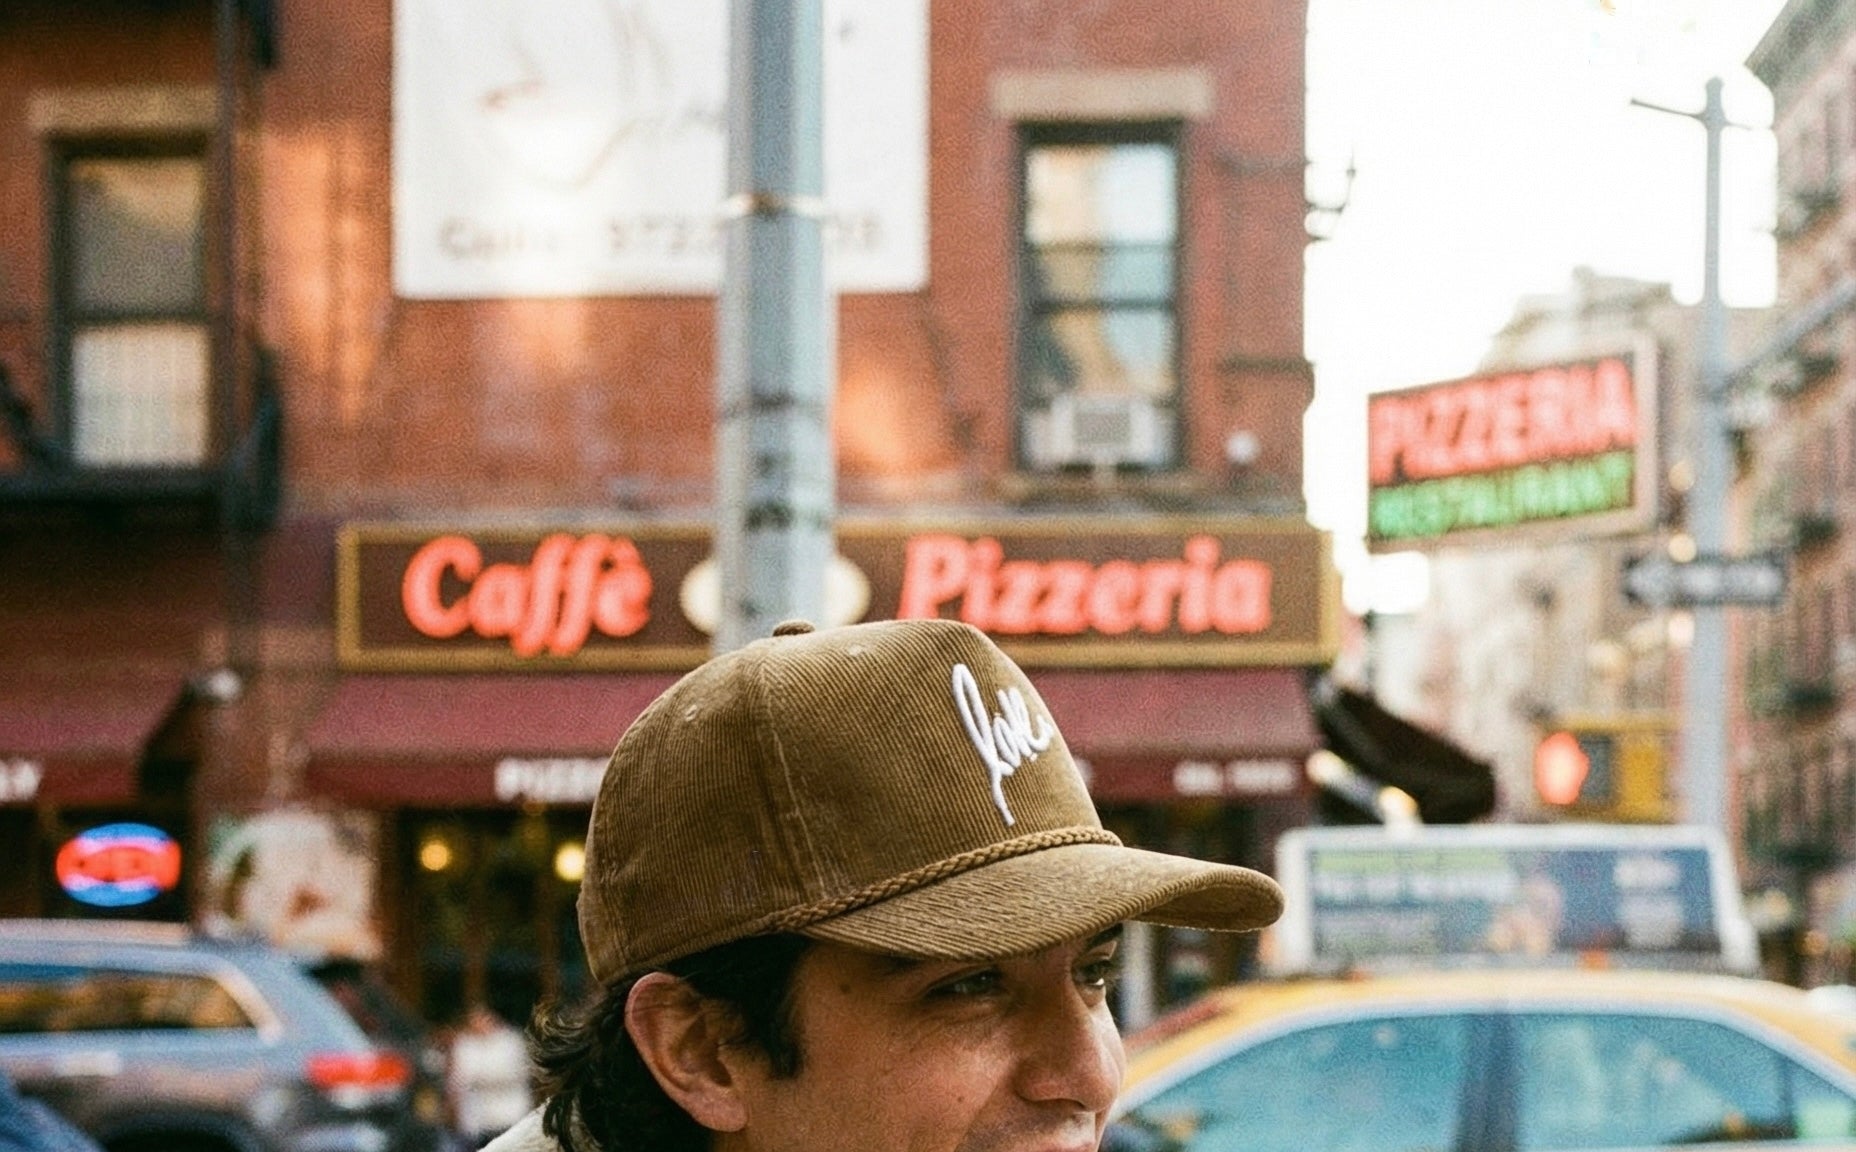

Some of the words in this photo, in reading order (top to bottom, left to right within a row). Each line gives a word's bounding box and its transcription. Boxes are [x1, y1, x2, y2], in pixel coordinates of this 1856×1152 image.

[1368, 357, 1636, 487] PIZZERIA
[402, 533, 654, 658] Caffè
[898, 532, 1271, 635] Pizzeria
